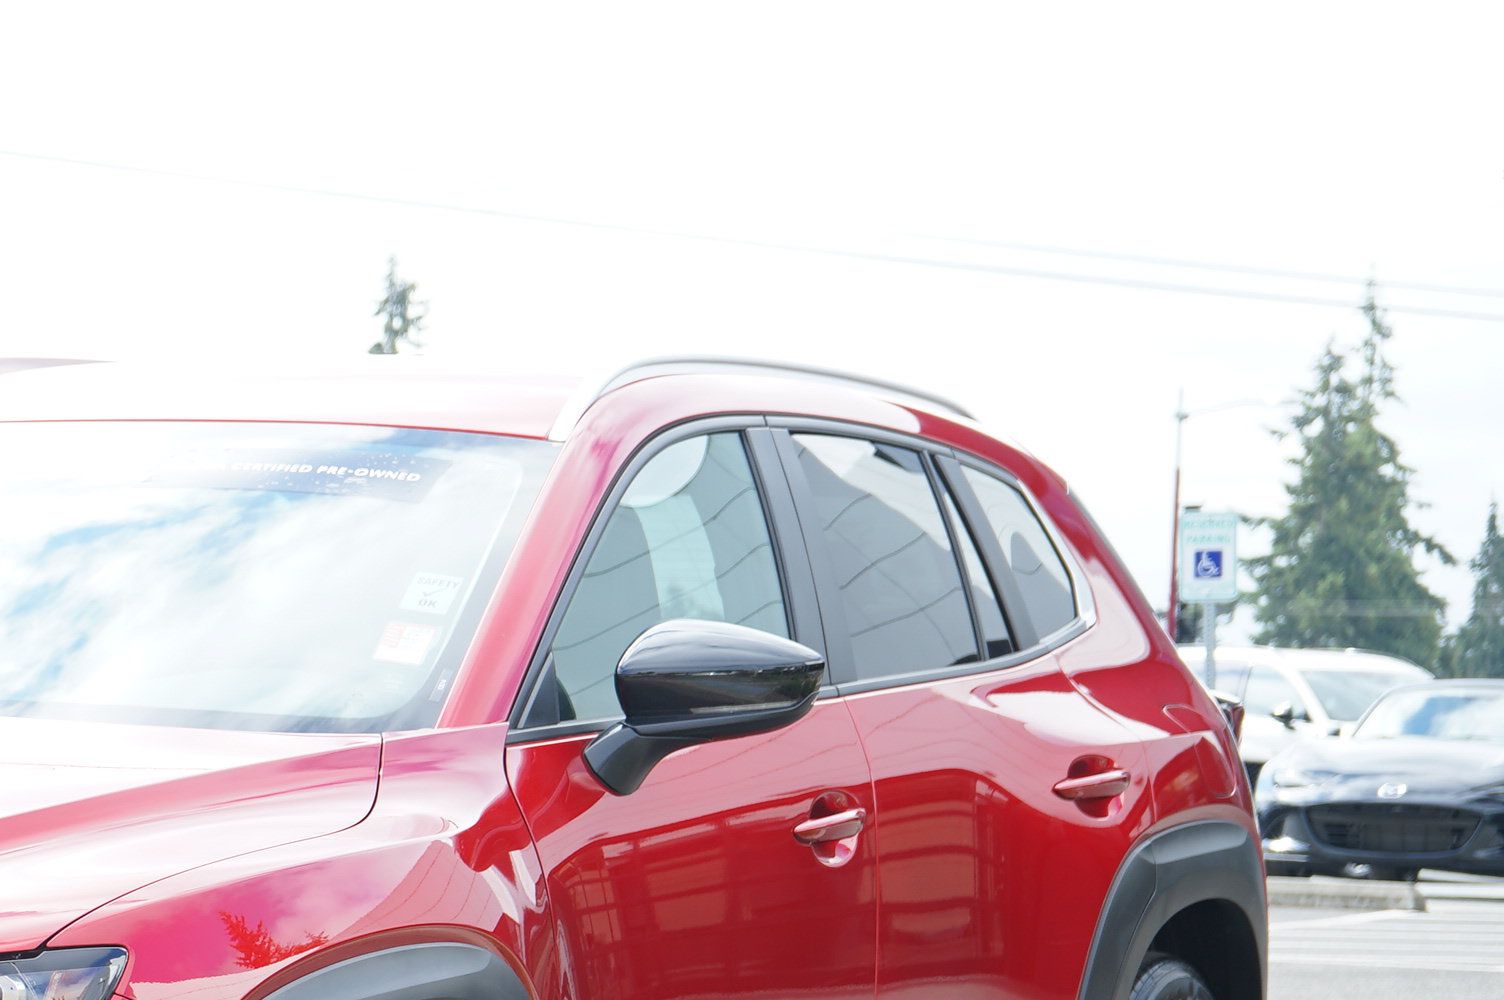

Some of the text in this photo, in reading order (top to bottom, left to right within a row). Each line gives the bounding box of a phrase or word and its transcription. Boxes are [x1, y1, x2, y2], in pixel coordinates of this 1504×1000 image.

[316, 465, 421, 482] PRE-OWNED
[417, 576, 460, 589] SAFETY
[417, 599, 439, 609] OK
